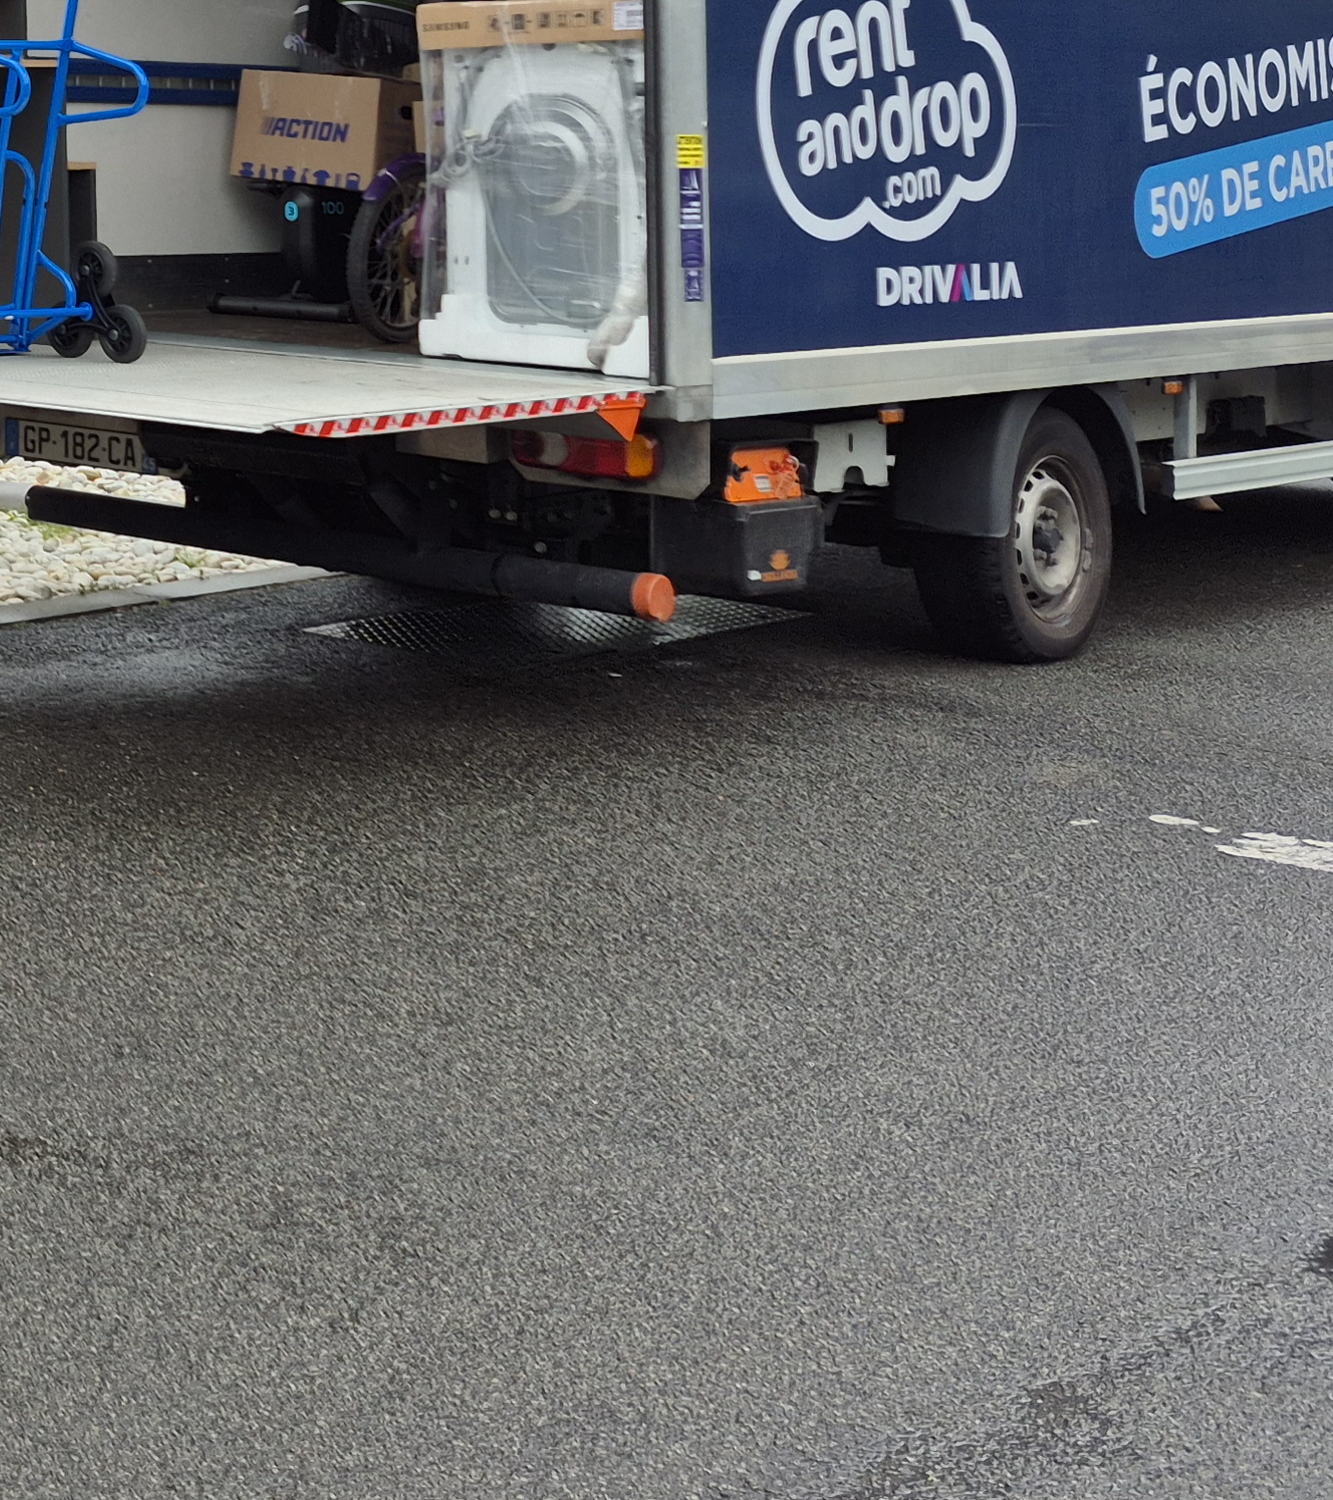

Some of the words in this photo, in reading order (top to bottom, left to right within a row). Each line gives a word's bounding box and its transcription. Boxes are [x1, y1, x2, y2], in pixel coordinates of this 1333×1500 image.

[1139, 37, 1333, 143] ÉCONOMI
[271, 117, 350, 143] ACTION
[796, 72, 990, 177] anddrop
[321, 201, 344, 215] 100
[882, 166, 941, 209] .com
[1150, 173, 1214, 237] 50%
[1221, 160, 1263, 217] DE
[876, 261, 1023, 306] DRIVALIA
[24, 425, 136, 468] GP-182-CA
